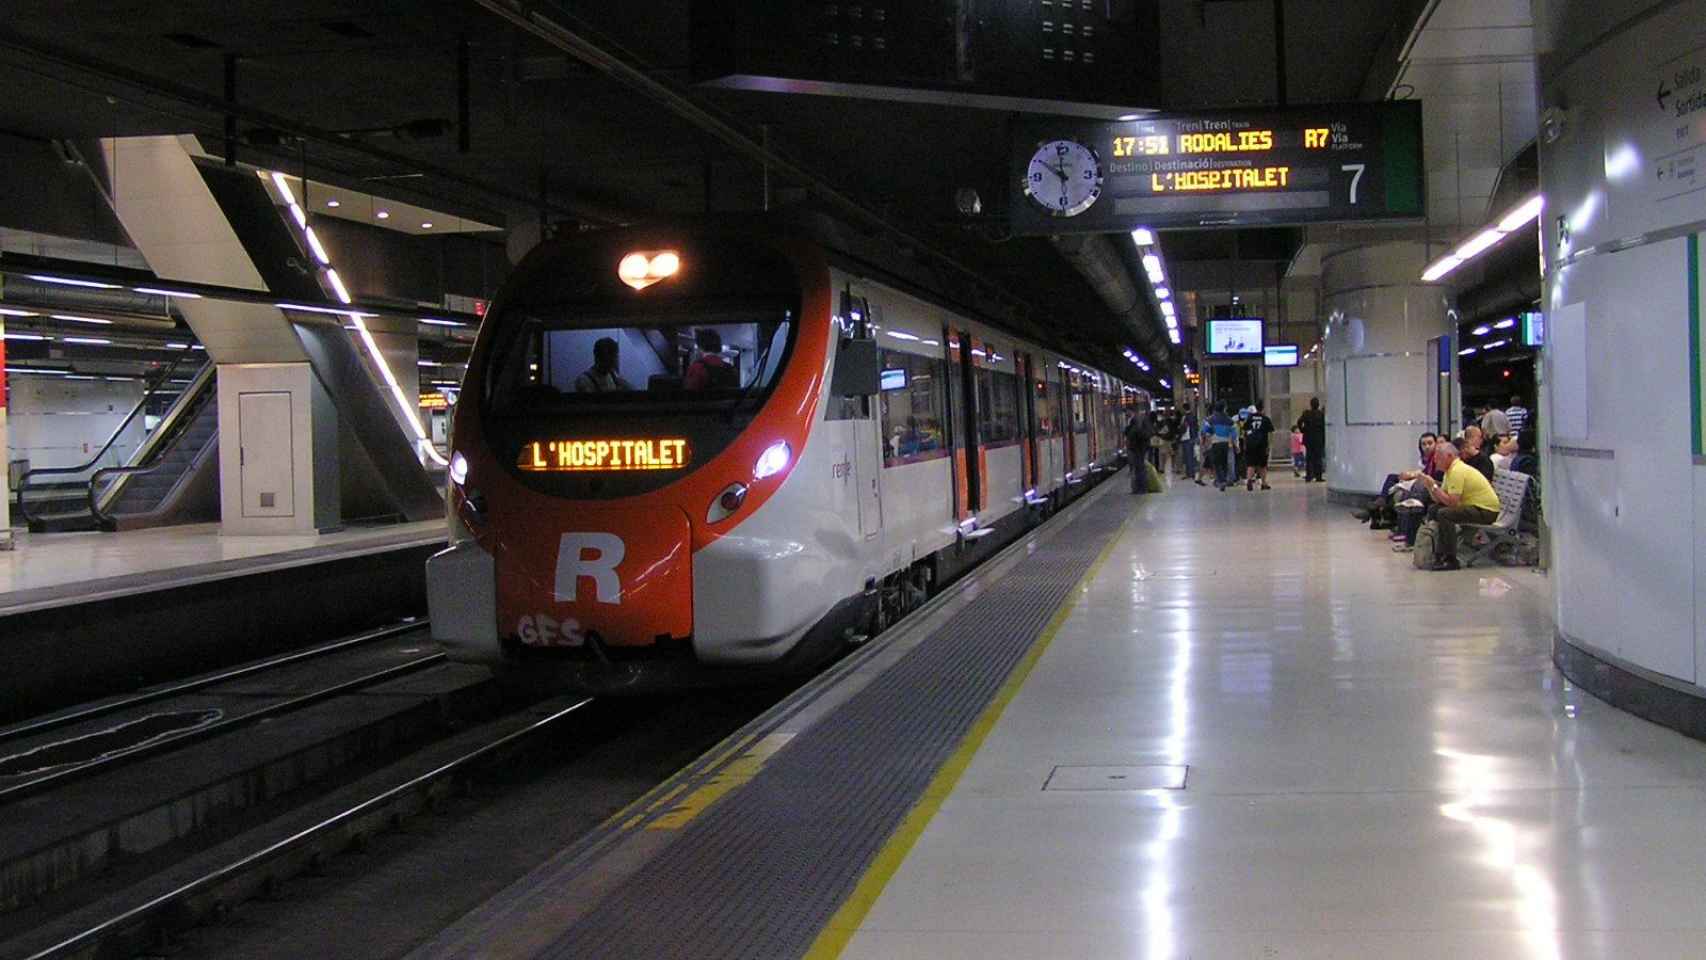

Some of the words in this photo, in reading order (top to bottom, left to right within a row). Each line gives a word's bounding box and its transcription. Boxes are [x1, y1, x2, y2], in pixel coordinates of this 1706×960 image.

[1204, 119, 1228, 130] Tren
[1180, 131, 1272, 153] RODALIES
[1110, 161, 1148, 173] Destino
[1155, 157, 1208, 170] Destinació
[1152, 167, 1288, 191] L'HOSPITALET
[1342, 164, 1365, 204] 7
[533, 440, 686, 467] L'HOSPITALET
[554, 532, 625, 605] R
